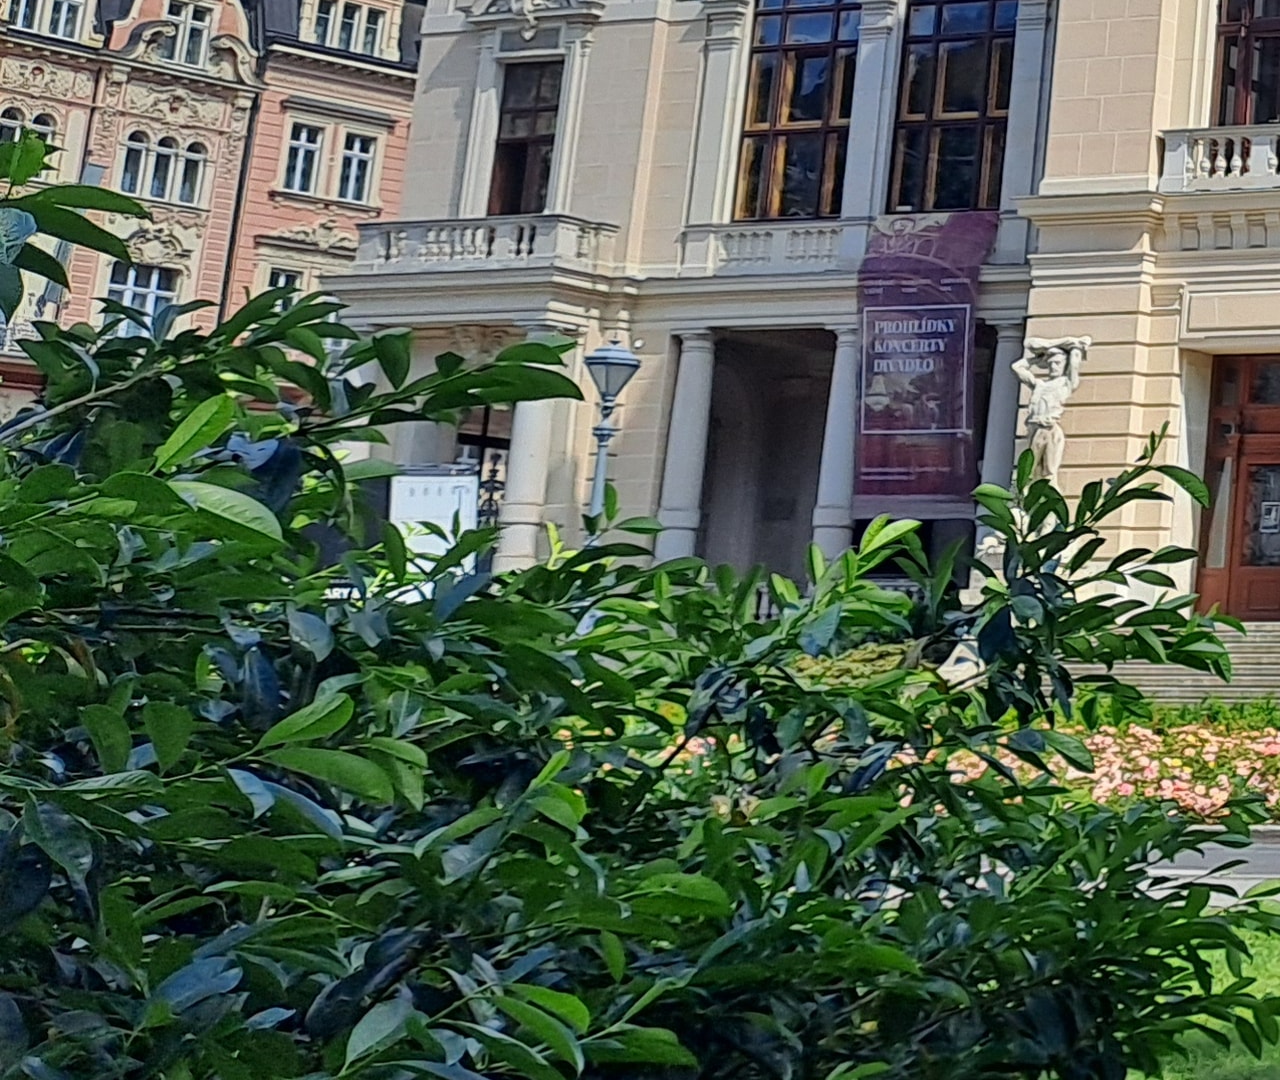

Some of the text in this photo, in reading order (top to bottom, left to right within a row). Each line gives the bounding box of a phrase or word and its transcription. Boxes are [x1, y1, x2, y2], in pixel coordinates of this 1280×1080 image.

[874, 316, 957, 334] PROHLÍDKY
[873, 338, 948, 353] KONCERTY
[873, 357, 935, 373] DIVADLO
